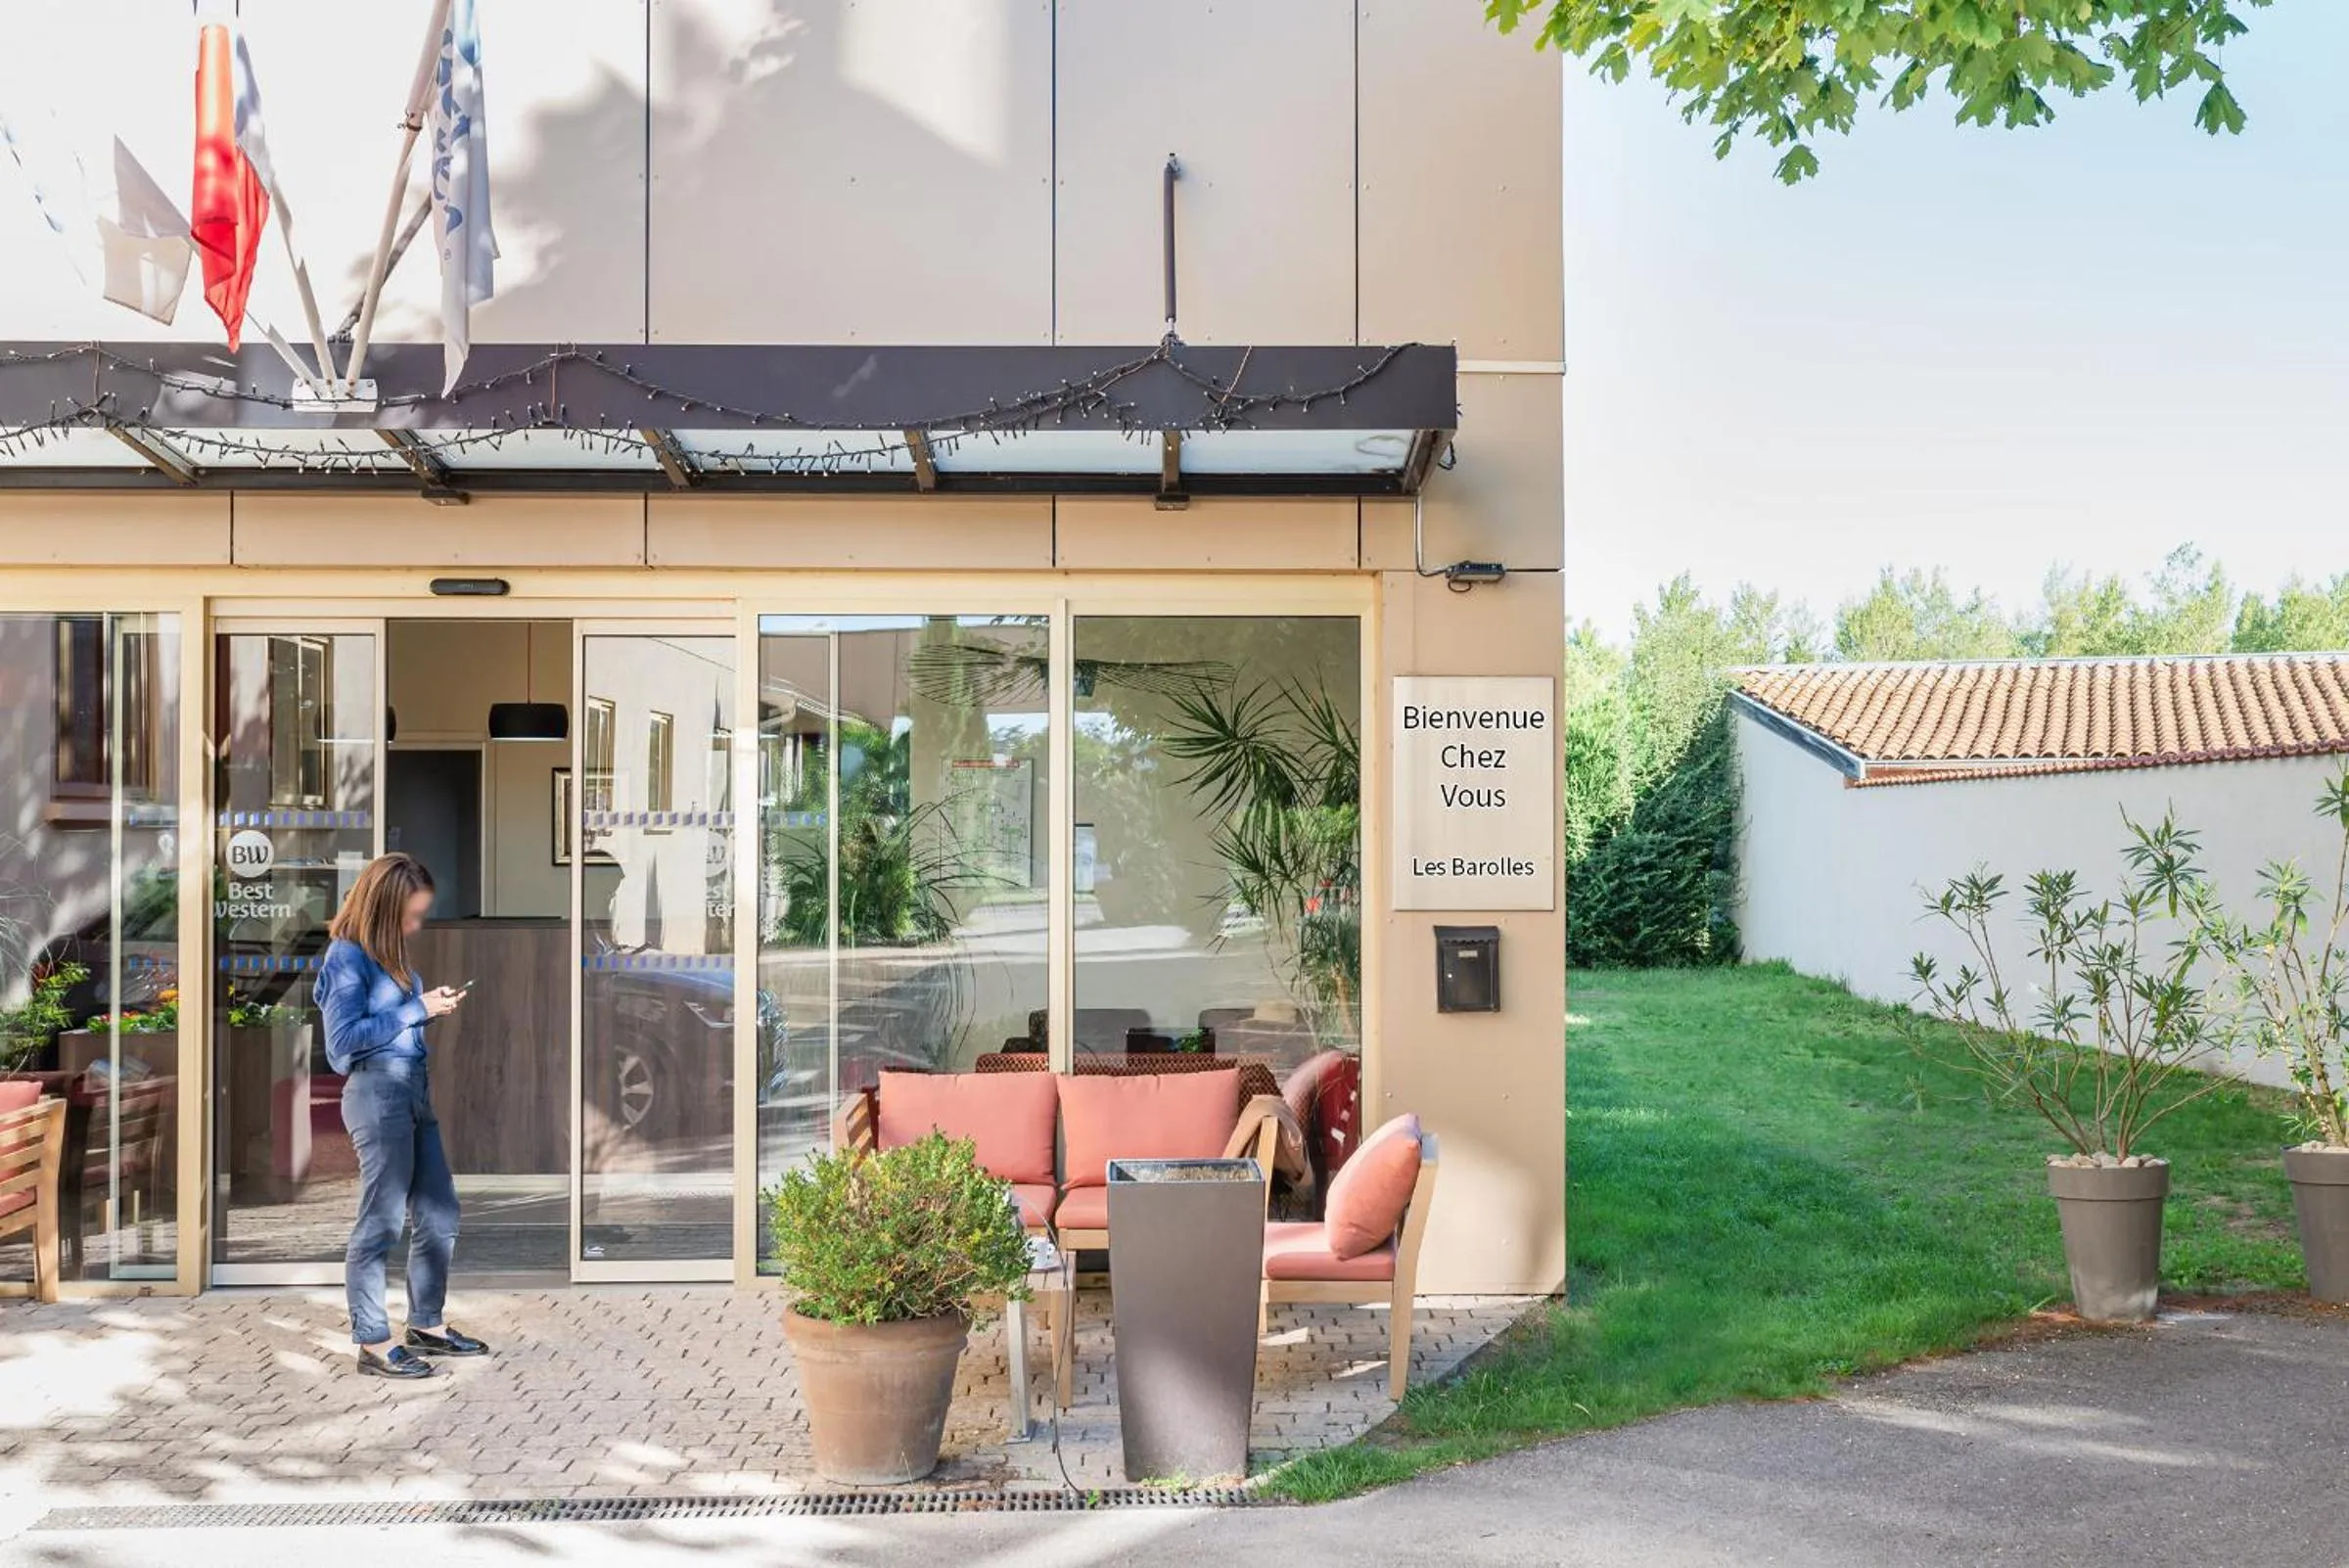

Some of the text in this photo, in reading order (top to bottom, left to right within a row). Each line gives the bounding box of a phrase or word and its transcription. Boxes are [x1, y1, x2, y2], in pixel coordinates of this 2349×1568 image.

[1404, 706, 1545, 729] Bienvenue
[1441, 744, 1506, 768] Chez
[1441, 784, 1506, 807] Vous
[232, 845, 269, 864] BW
[1413, 857, 1535, 876] Les Barolles
[228, 882, 274, 899] Best
